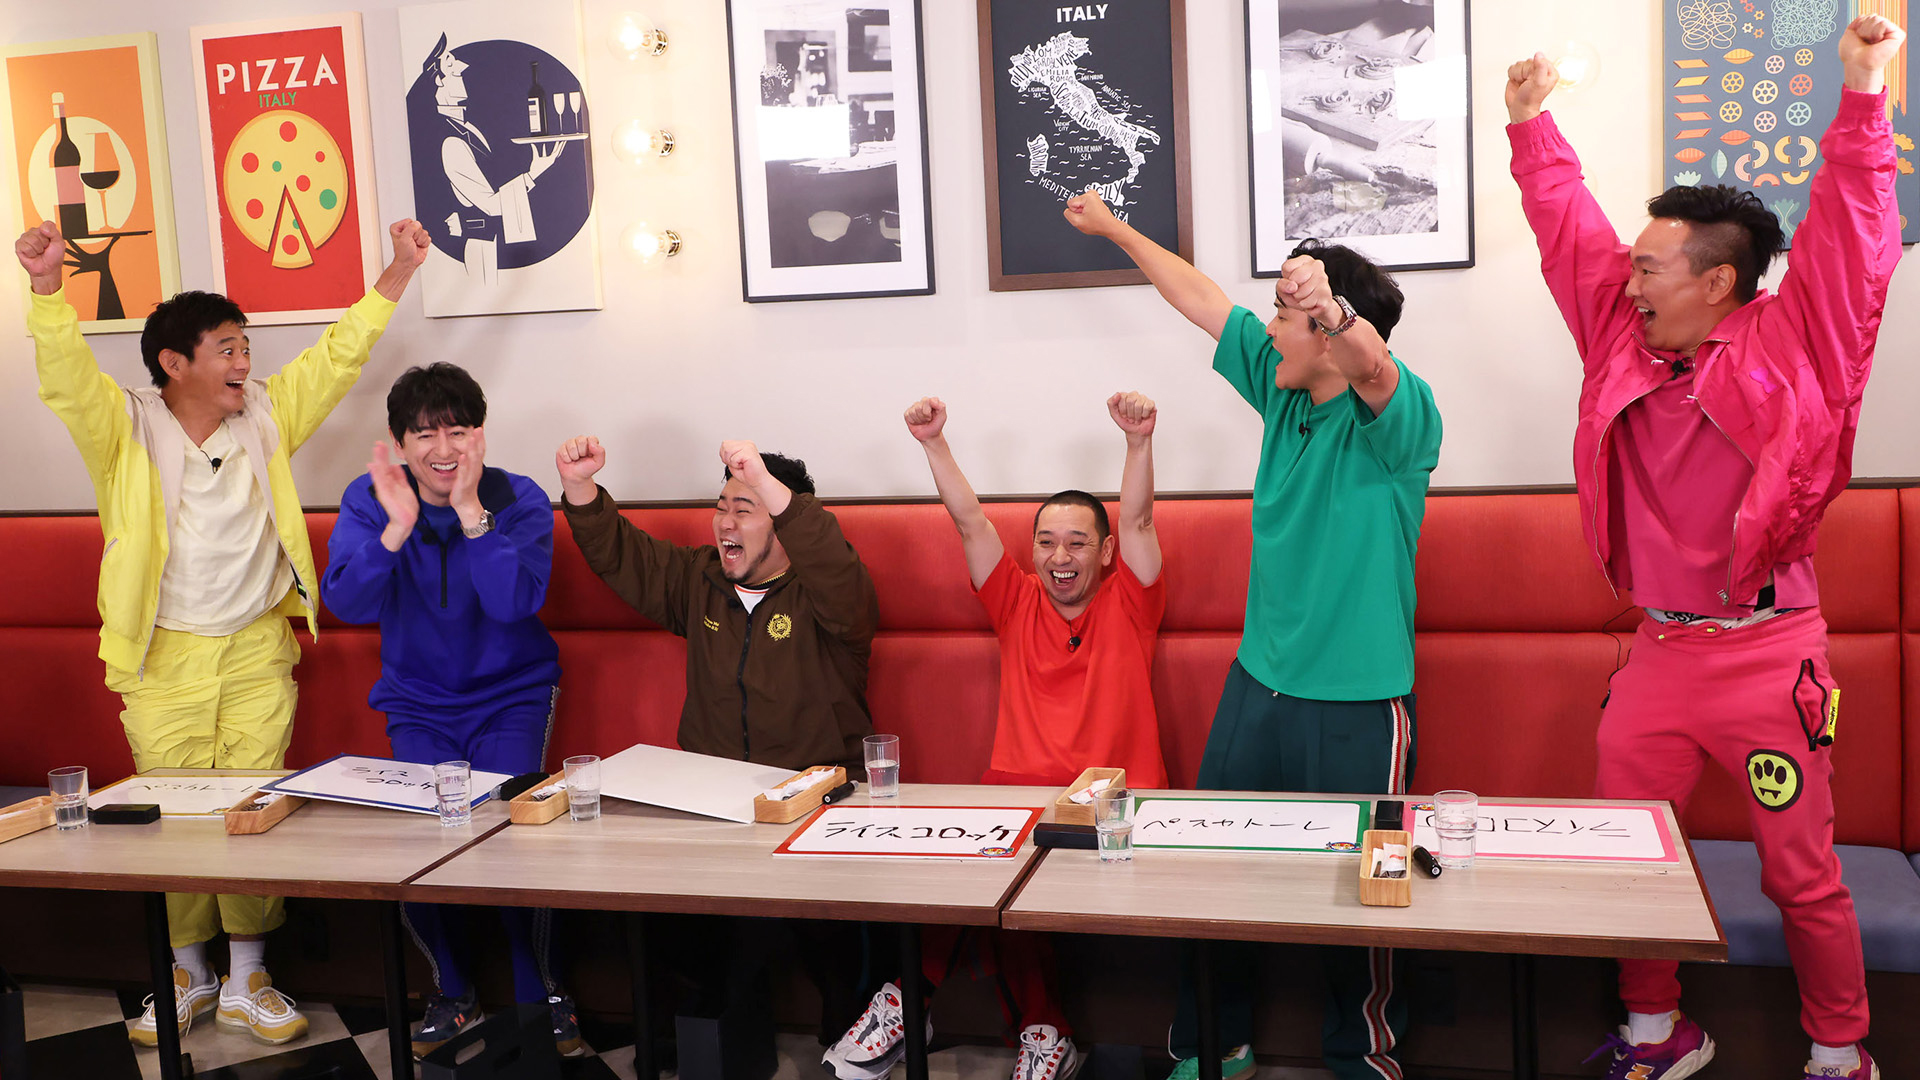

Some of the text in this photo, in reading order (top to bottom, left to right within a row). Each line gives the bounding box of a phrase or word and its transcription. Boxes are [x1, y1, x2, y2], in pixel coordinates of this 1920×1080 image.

[1056, 3, 1109, 23] ITALY
[216, 53, 339, 95] PIZZA
[258, 91, 297, 108] ITALY
[1080, 153, 1092, 161] SEA
[1039, 177, 1079, 201] MEDITER
[1112, 208, 1129, 224] SEA
[352, 766, 408, 777] ライス
[824, 821, 1020, 842] ライスコロッケ
